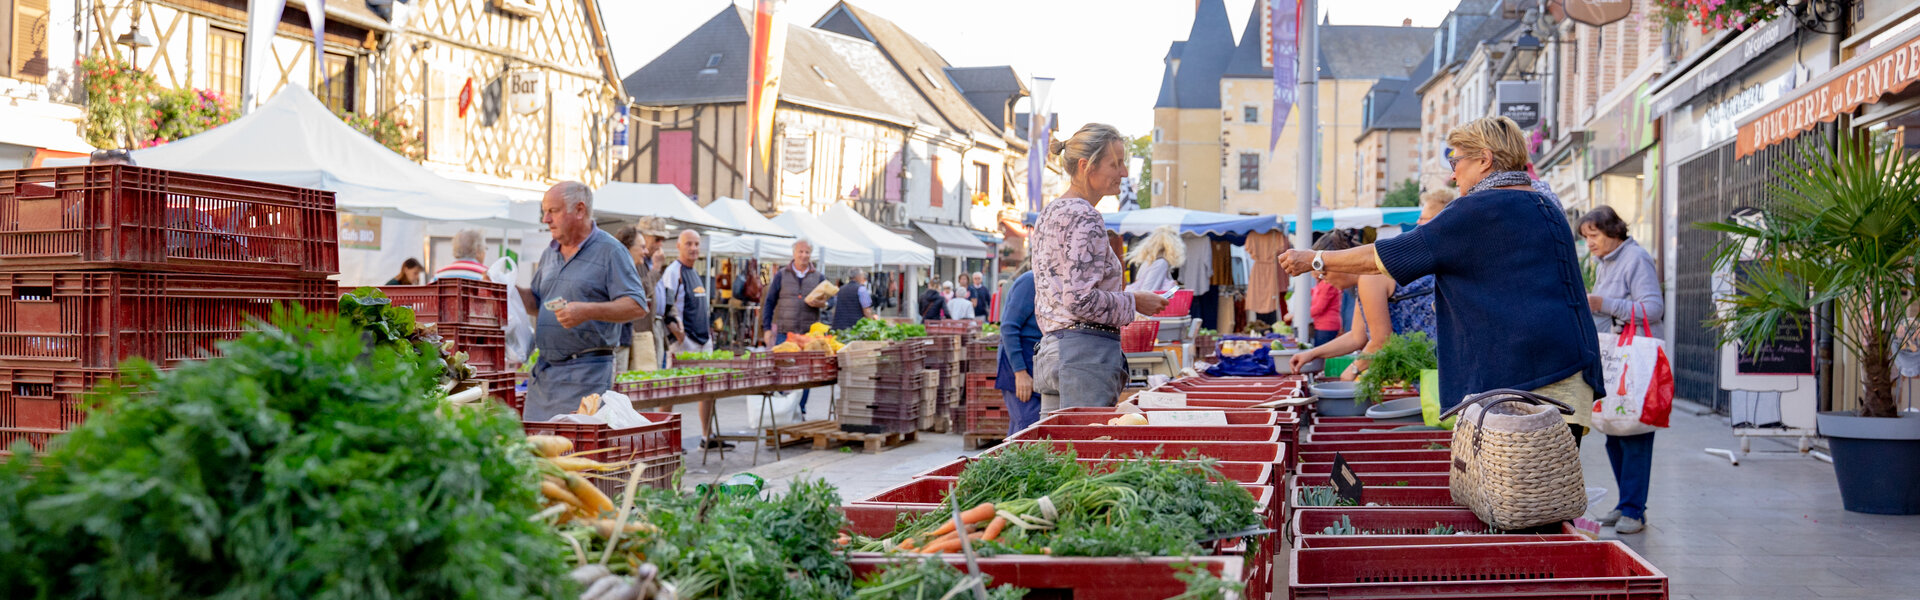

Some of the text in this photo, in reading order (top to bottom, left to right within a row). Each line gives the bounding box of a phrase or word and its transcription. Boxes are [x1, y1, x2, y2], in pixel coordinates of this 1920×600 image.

[512, 74, 538, 94] Bar
[1754, 86, 1830, 148] BOUCHERIE
[1832, 91, 1843, 113] au
[1845, 39, 1920, 108] CENTRE
